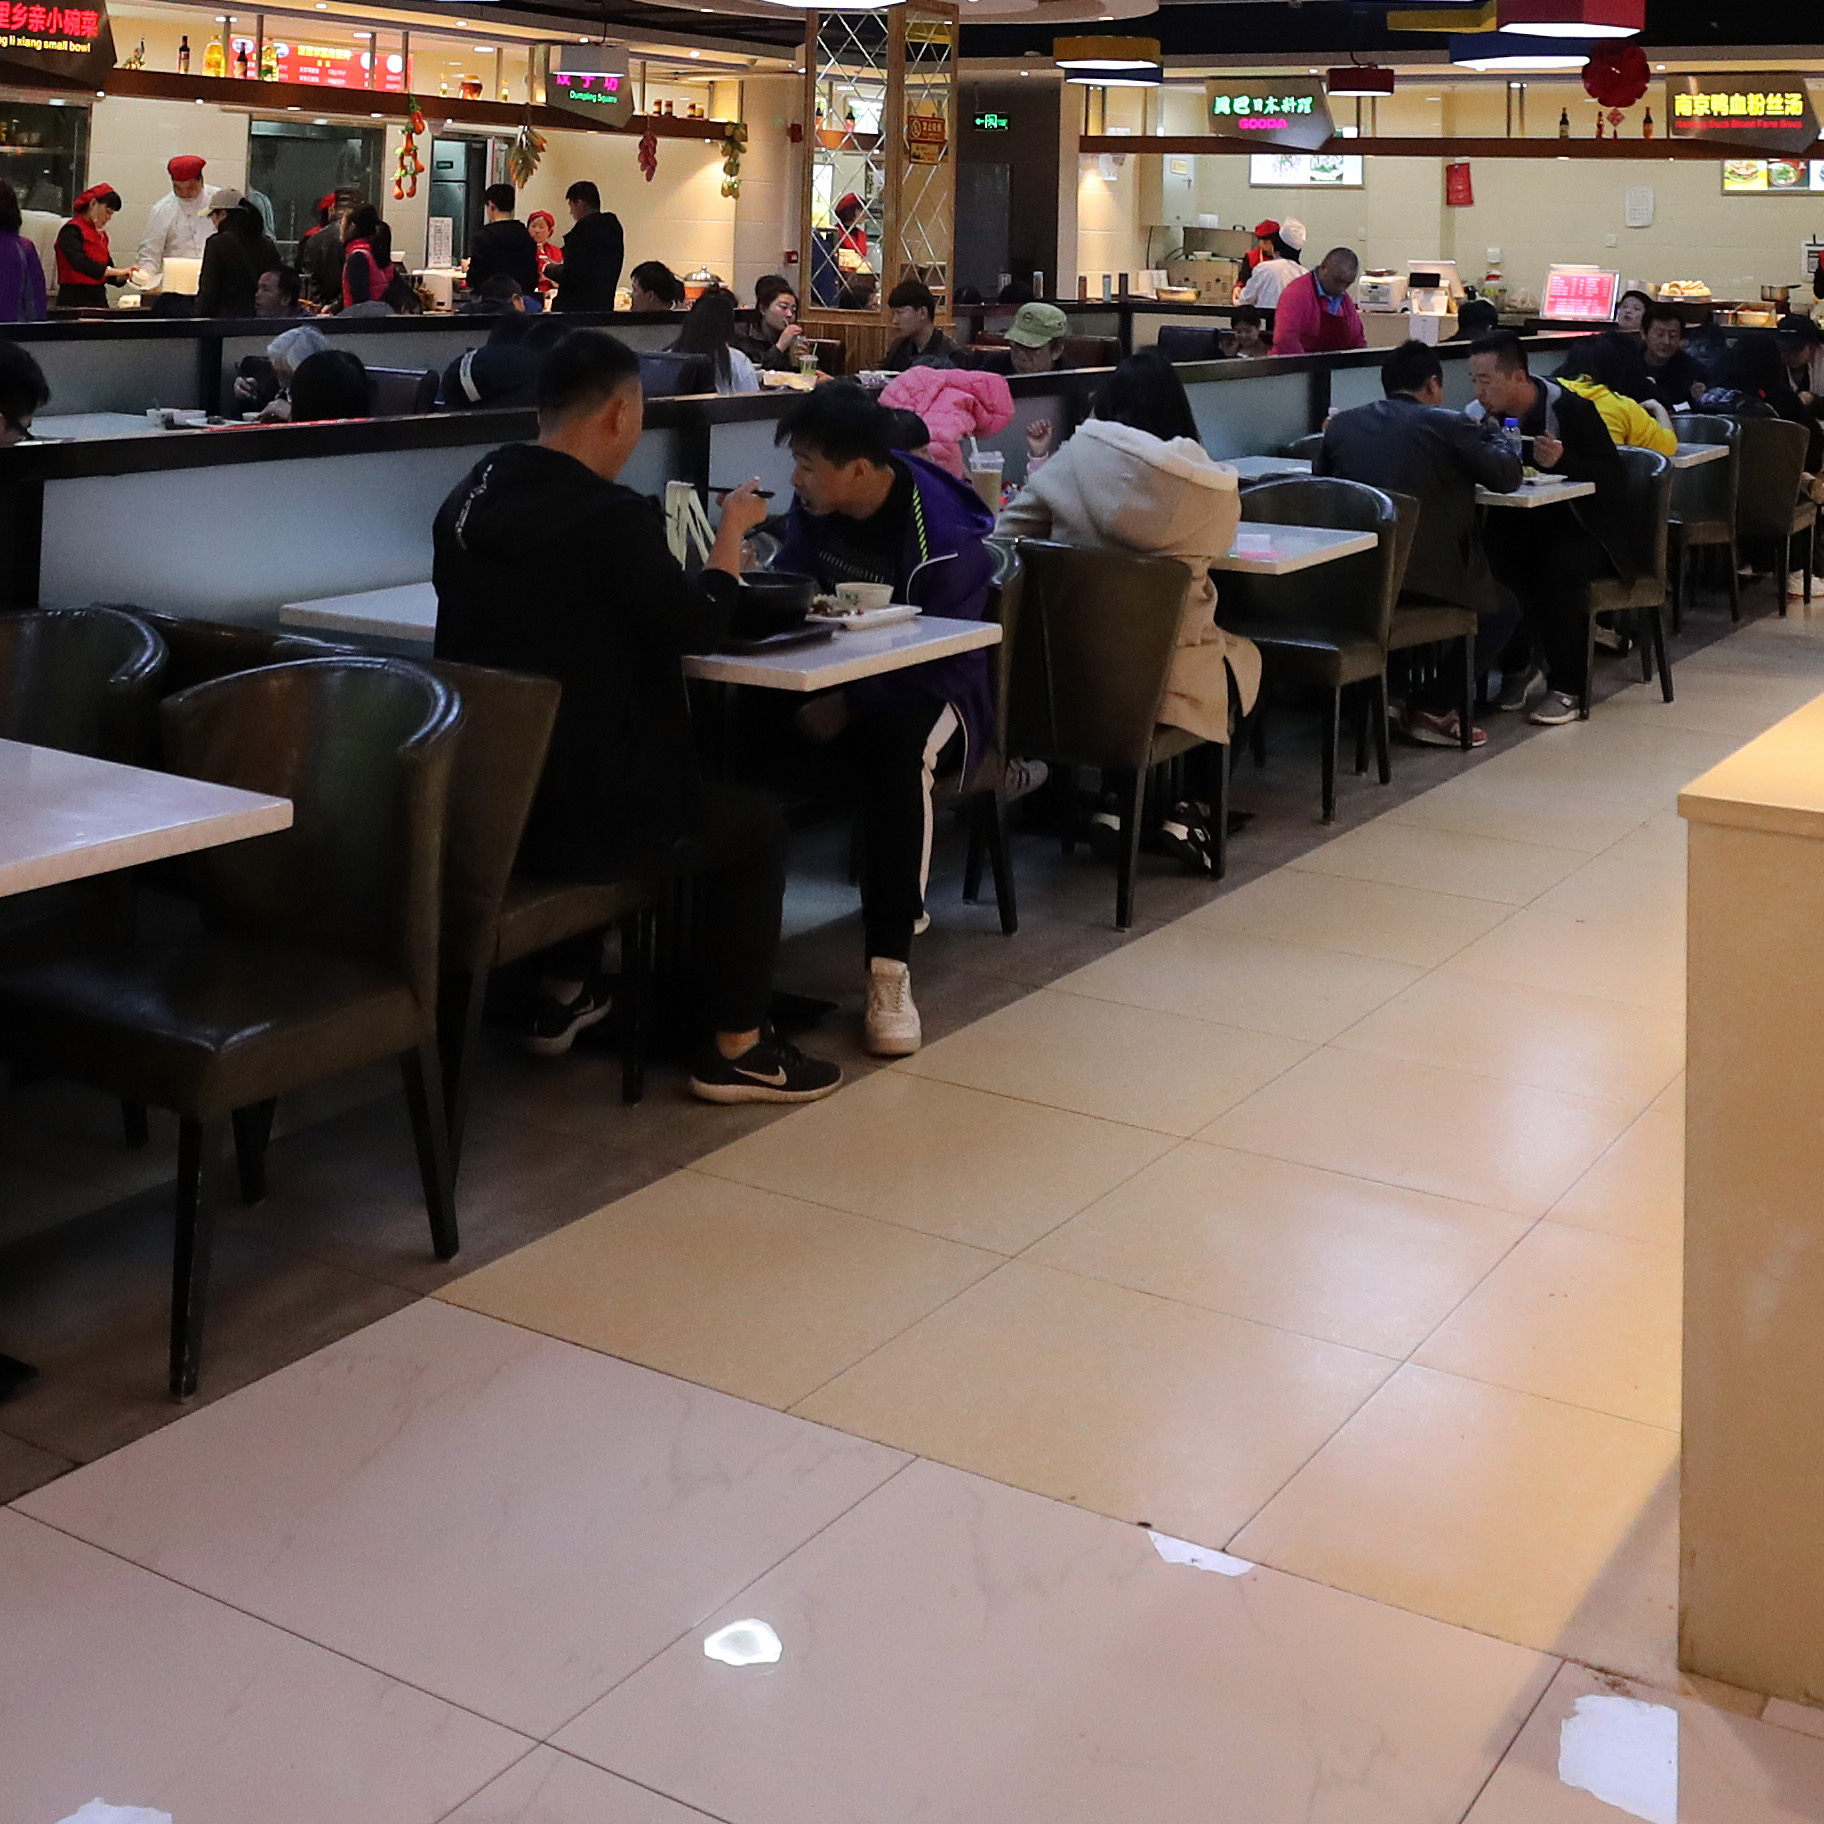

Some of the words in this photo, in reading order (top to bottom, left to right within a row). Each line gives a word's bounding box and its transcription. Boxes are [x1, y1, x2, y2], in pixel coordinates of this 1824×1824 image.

[17, 36, 42, 50] xiang
[43, 40, 68, 51] small
[69, 41, 91, 53] bowl
[1674, 93, 1804, 116] 南京鸭血粉丝汤
